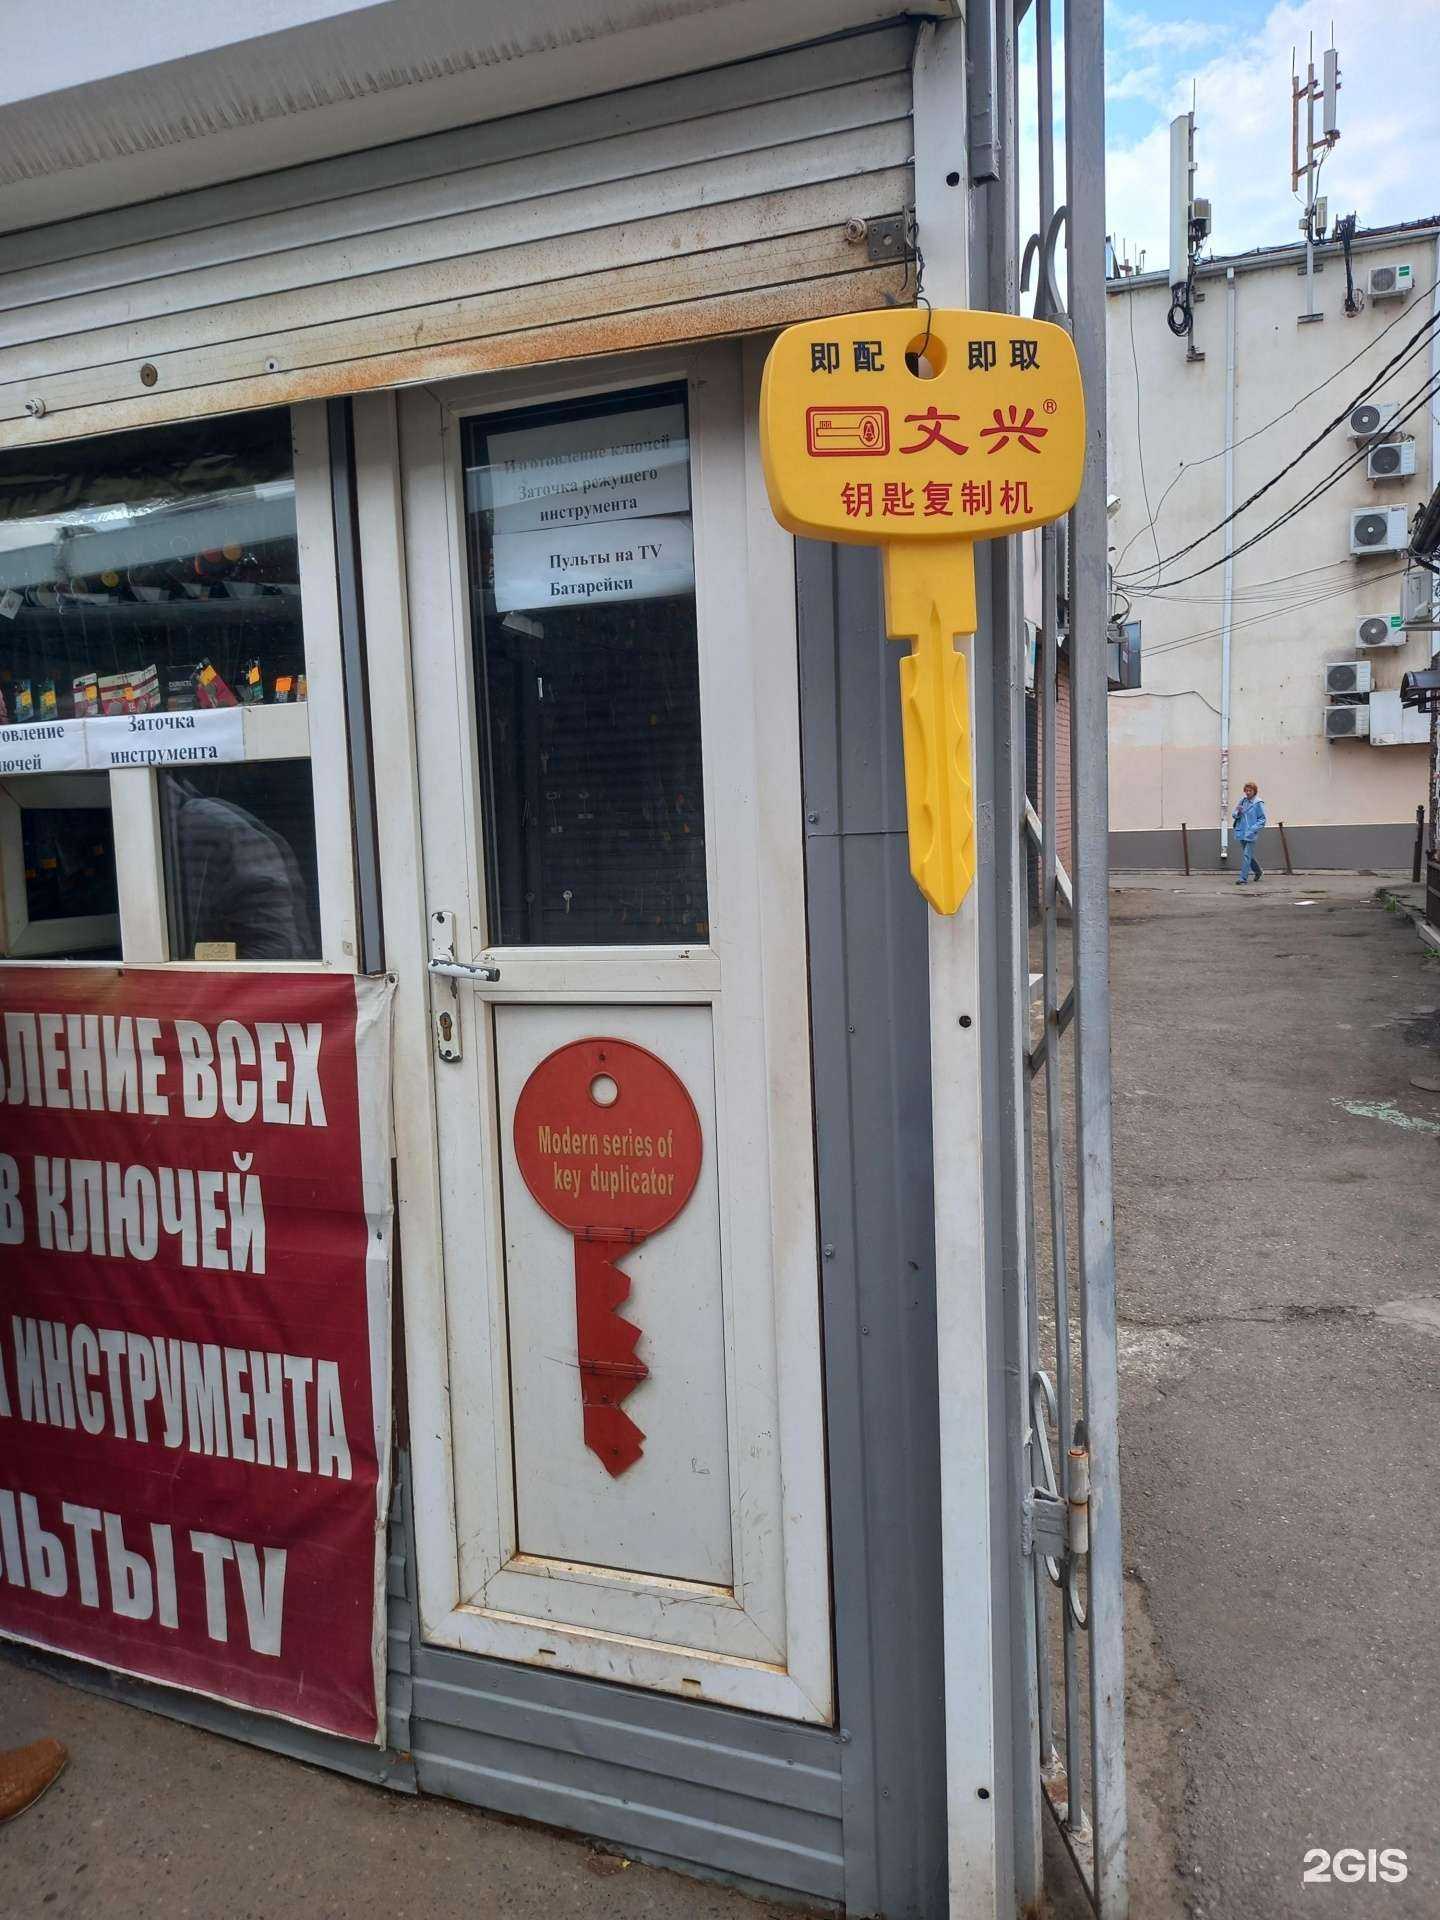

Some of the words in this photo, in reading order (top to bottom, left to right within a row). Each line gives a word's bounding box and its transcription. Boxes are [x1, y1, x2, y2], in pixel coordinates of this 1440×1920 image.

[810, 340, 884, 373] 即配
[967, 339, 1040, 371] 即取
[609, 433, 670, 456] ключей
[519, 482, 577, 499] Заточка
[840, 479, 1033, 517] 钥匙复制机
[540, 498, 637, 521] инструмента
[550, 553, 610, 571] Пульты
[616, 550, 633, 561] на
[637, 543, 662, 559] TV
[550, 577, 633, 596] Батарейки
[0, 726, 64, 742] овление
[127, 714, 195, 732] Заточка
[0, 754, 41, 772] ючей
[110, 742, 218, 766] инструмента
[0, 1012, 170, 1117] ЛЕНИЕ
[174, 1019, 329, 1127] ВСЕХ
[538, 1124, 598, 1154] Modern
[602, 1128, 652, 1157] series
[657, 1129, 673, 1158] of
[553, 1162, 581, 1197] key
[590, 1164, 674, 1199] duplicator
[34, 1150, 267, 1275] КЛЮЧЕЙ
[12, 1313, 353, 1481] ИНСТРУМЕНТА
[189, 1529, 288, 1658] TV
